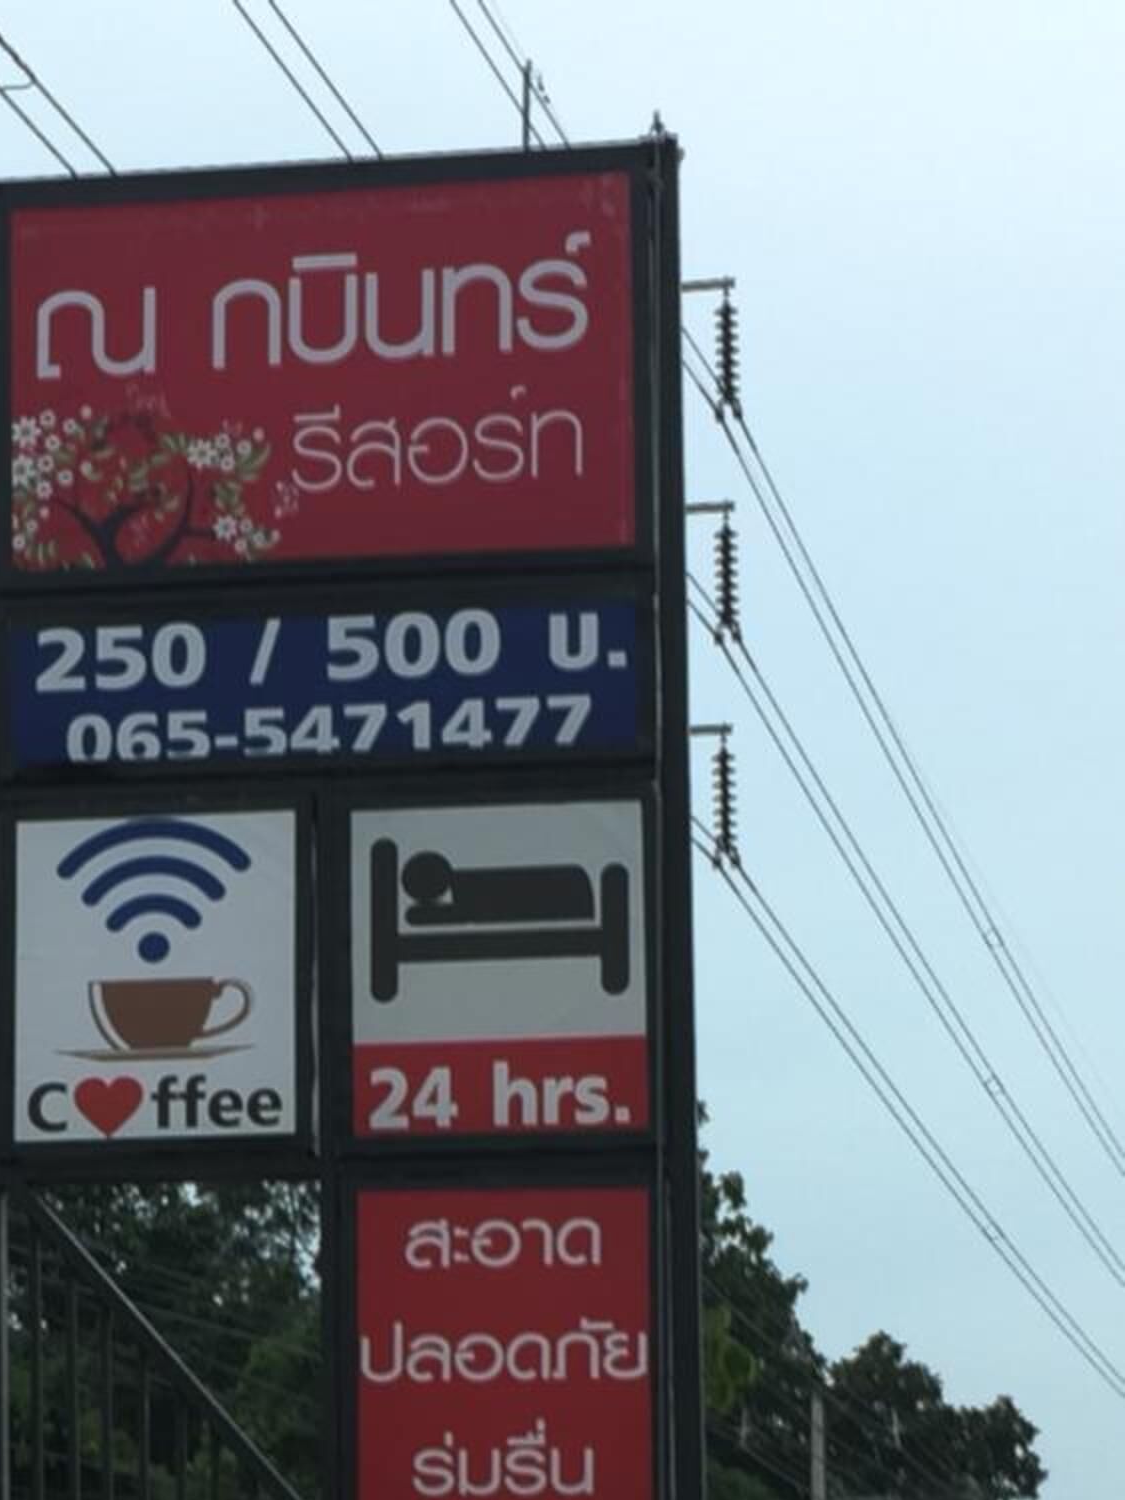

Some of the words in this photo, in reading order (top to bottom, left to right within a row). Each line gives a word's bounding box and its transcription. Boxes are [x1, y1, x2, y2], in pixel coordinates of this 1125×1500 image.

[36, 286, 156, 378] ณ
[212, 231, 591, 369] กบินทร์
[292, 386, 583, 492] รีสอร์ท
[35, 623, 206, 692] 250
[249, 618, 281, 685] /
[326, 609, 502, 681] 500
[66, 694, 593, 763] 065-5471477
[368, 1066, 459, 1130] 24
[492, 1059, 631, 1127] hrs.
[404, 1218, 602, 1269] สะอาด
[360, 1316, 649, 1383] ปลอดภัย
[412, 1417, 594, 1497] ร่มรื่น
